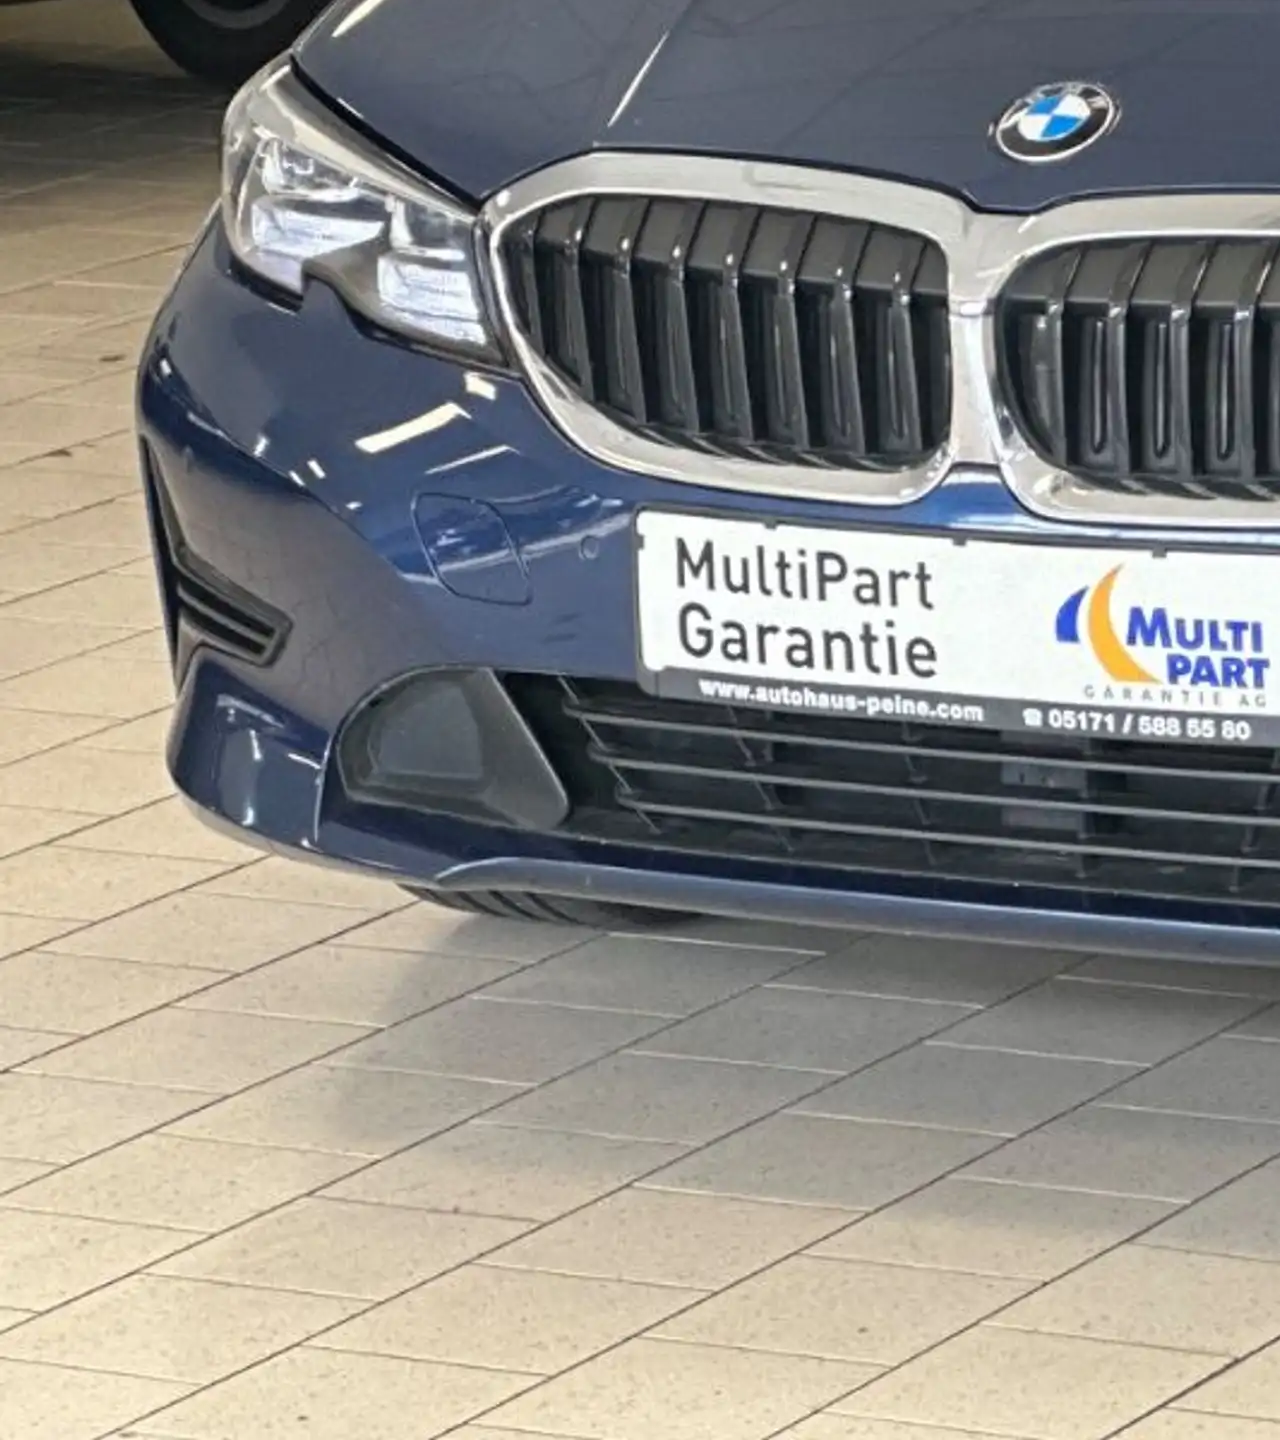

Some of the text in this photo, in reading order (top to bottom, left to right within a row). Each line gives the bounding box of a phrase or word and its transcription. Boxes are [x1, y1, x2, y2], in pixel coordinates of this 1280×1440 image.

[676, 537, 934, 611] MultiPart
[678, 601, 938, 679] Garantie
[1126, 605, 1264, 653] MULTI
[1166, 652, 1270, 690] PART
[698, 677, 985, 723] www.autohaus-peine.com
[1083, 684, 1267, 708] GARANTIE AG
[1048, 708, 1115, 733] 05171
